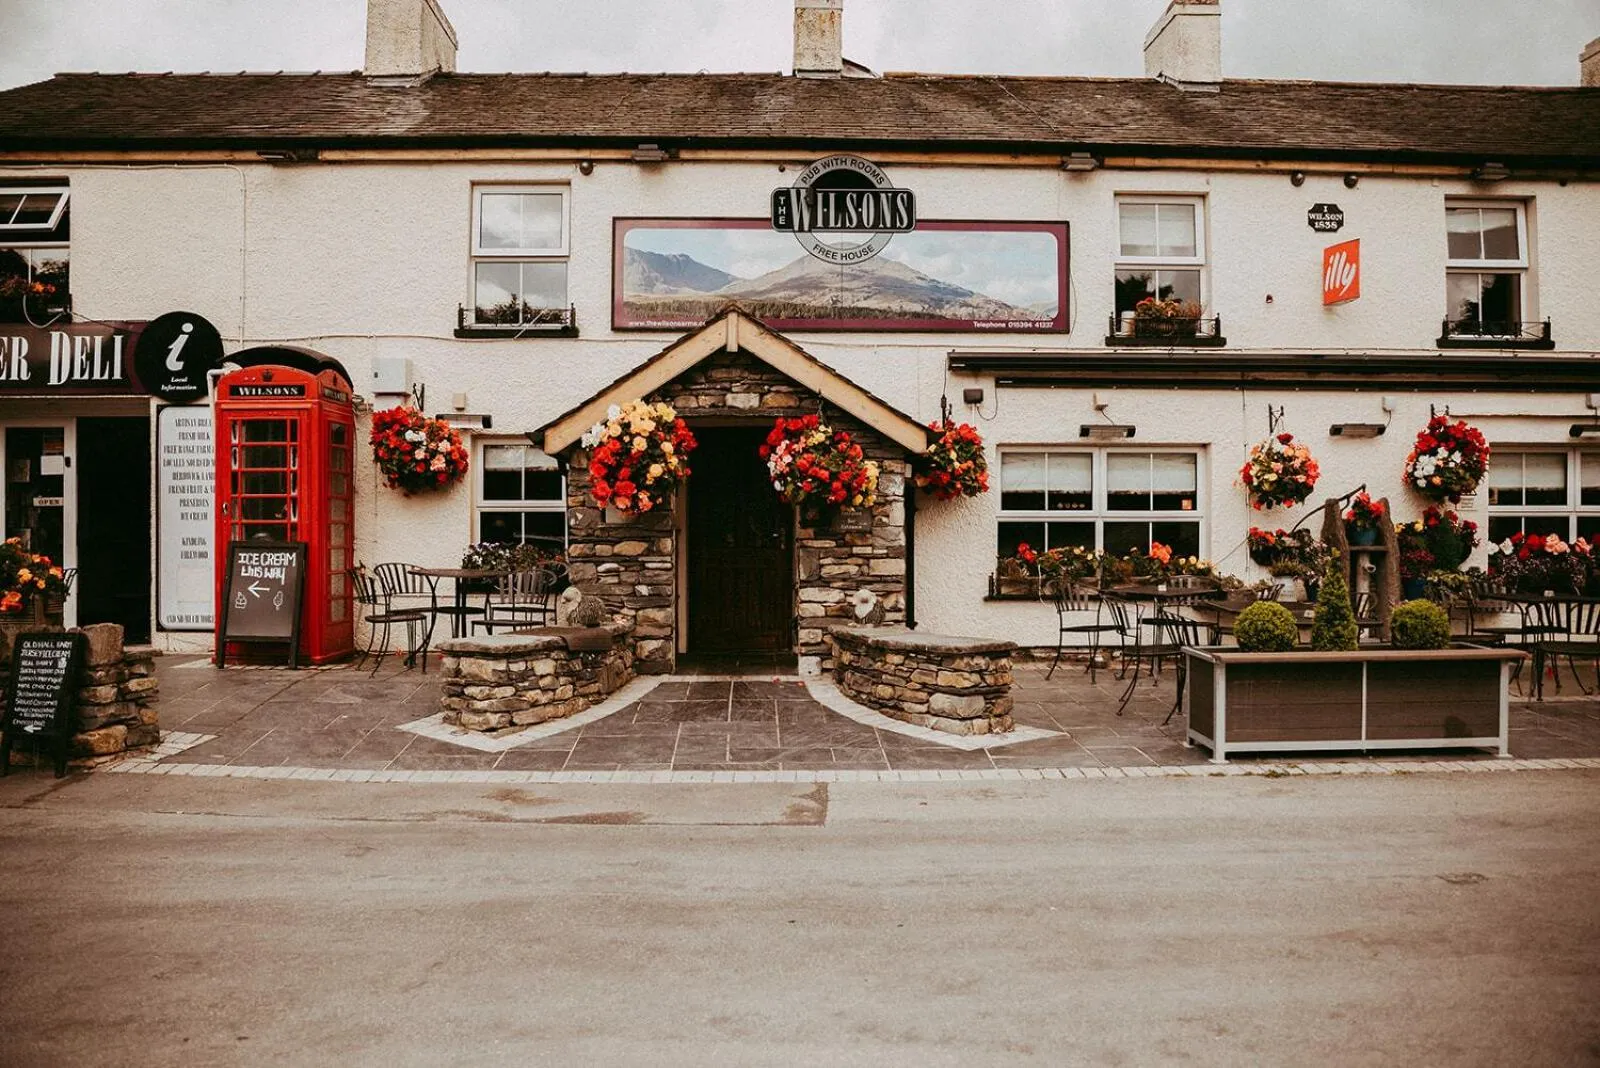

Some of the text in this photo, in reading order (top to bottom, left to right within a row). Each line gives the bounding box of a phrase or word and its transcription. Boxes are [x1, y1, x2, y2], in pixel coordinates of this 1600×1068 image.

[801, 157, 885, 185] PUB WITH ROOMS
[778, 196, 786, 225] THE
[790, 188, 908, 232] WILSONS
[1308, 212, 1343, 221] WILSON
[813, 244, 875, 261] FREE HOUSE
[1324, 250, 1356, 297] illy
[973, 321, 1006, 329] Telephone
[47, 331, 124, 385] DELI
[161, 384, 197, 392] Information
[239, 386, 298, 396] WILSONS
[178, 432, 196, 440] FRESH
[163, 445, 176, 454] FREE
[178, 445, 195, 454] RANGE
[163, 458, 185, 467] LOCALLY
[186, 458, 210, 467] SOURCED
[168, 485, 186, 494] FRESH
[187, 485, 203, 494] FRUIT
[204, 486, 209, 494] &
[179, 498, 209, 507] PRESERVES
[180, 512, 208, 520] ICE CREAM
[182, 537, 207, 546] KINDLING
[180, 550, 209, 559] FIREWOOD
[238, 552, 296, 567] ICE CREAM
[23, 640, 37, 648] OLD
[38, 640, 54, 648] HALL
